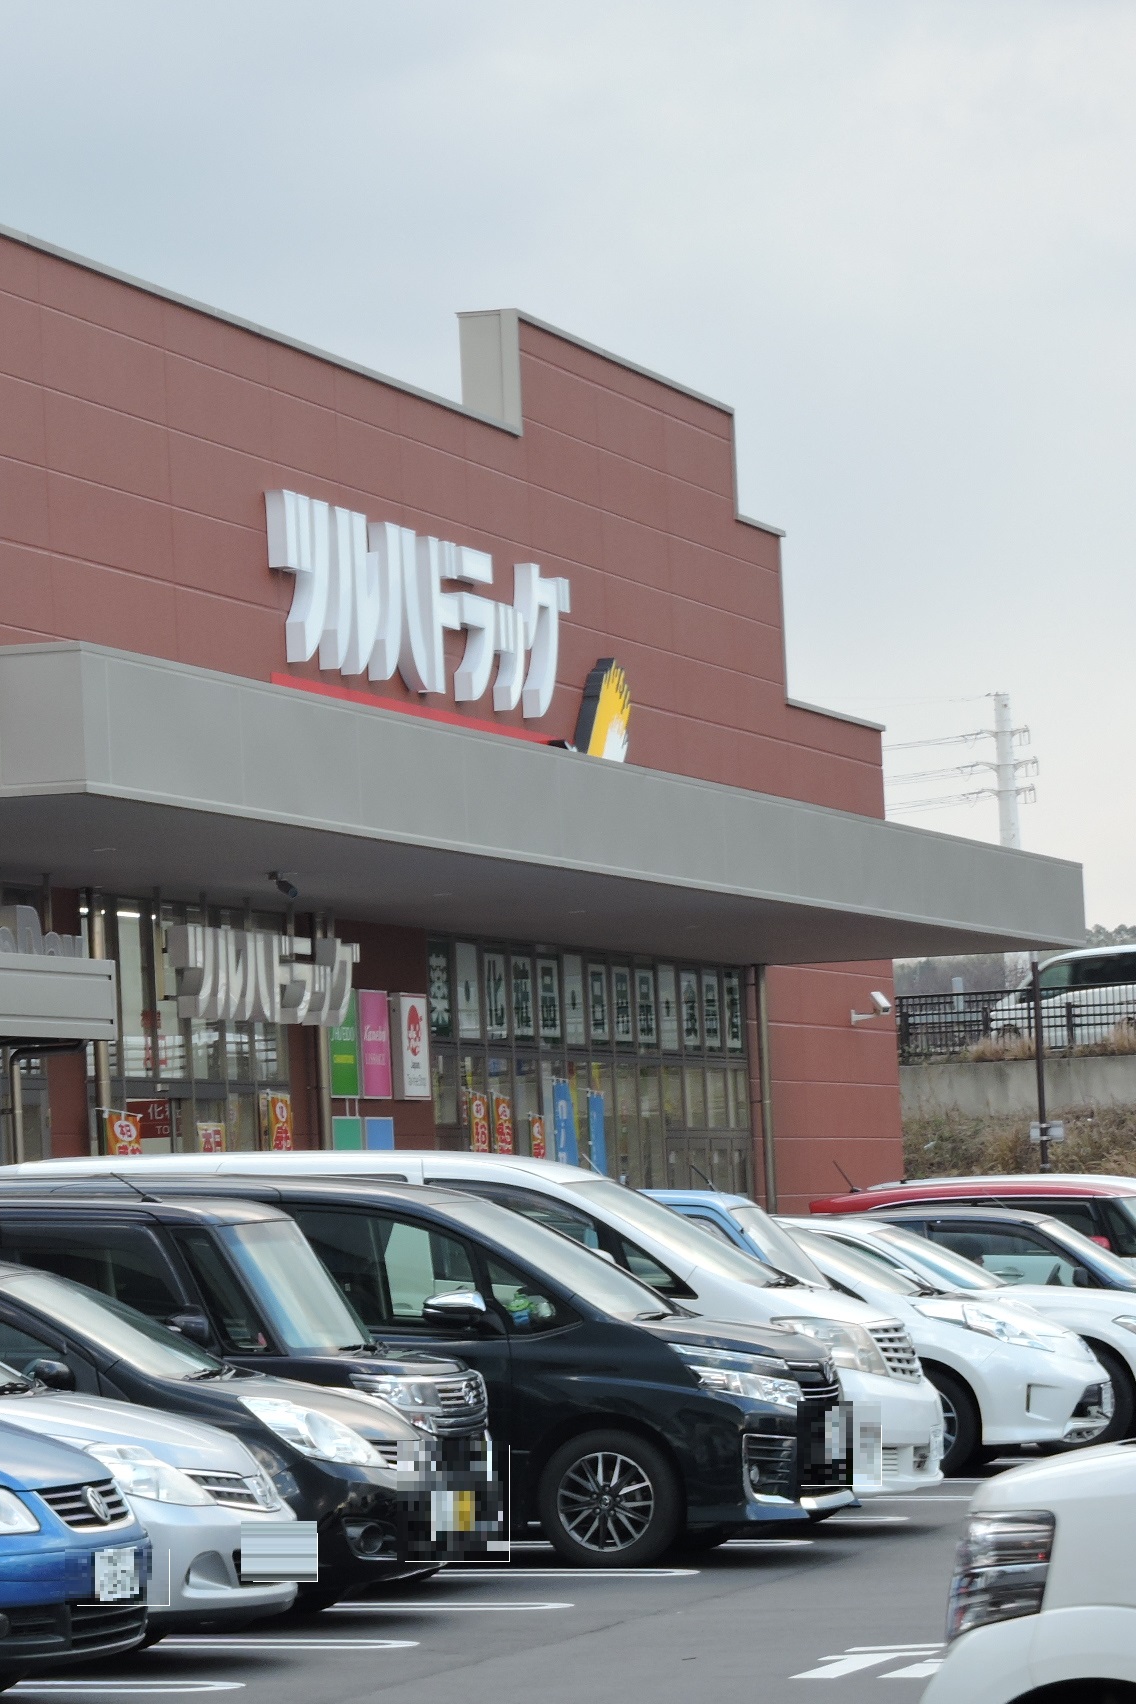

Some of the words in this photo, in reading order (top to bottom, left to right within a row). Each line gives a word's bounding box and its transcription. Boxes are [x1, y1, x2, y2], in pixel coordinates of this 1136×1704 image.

[265, 489, 570, 719] ツルハドラッグ
[167, 924, 360, 1027] ツルハドラッグ
